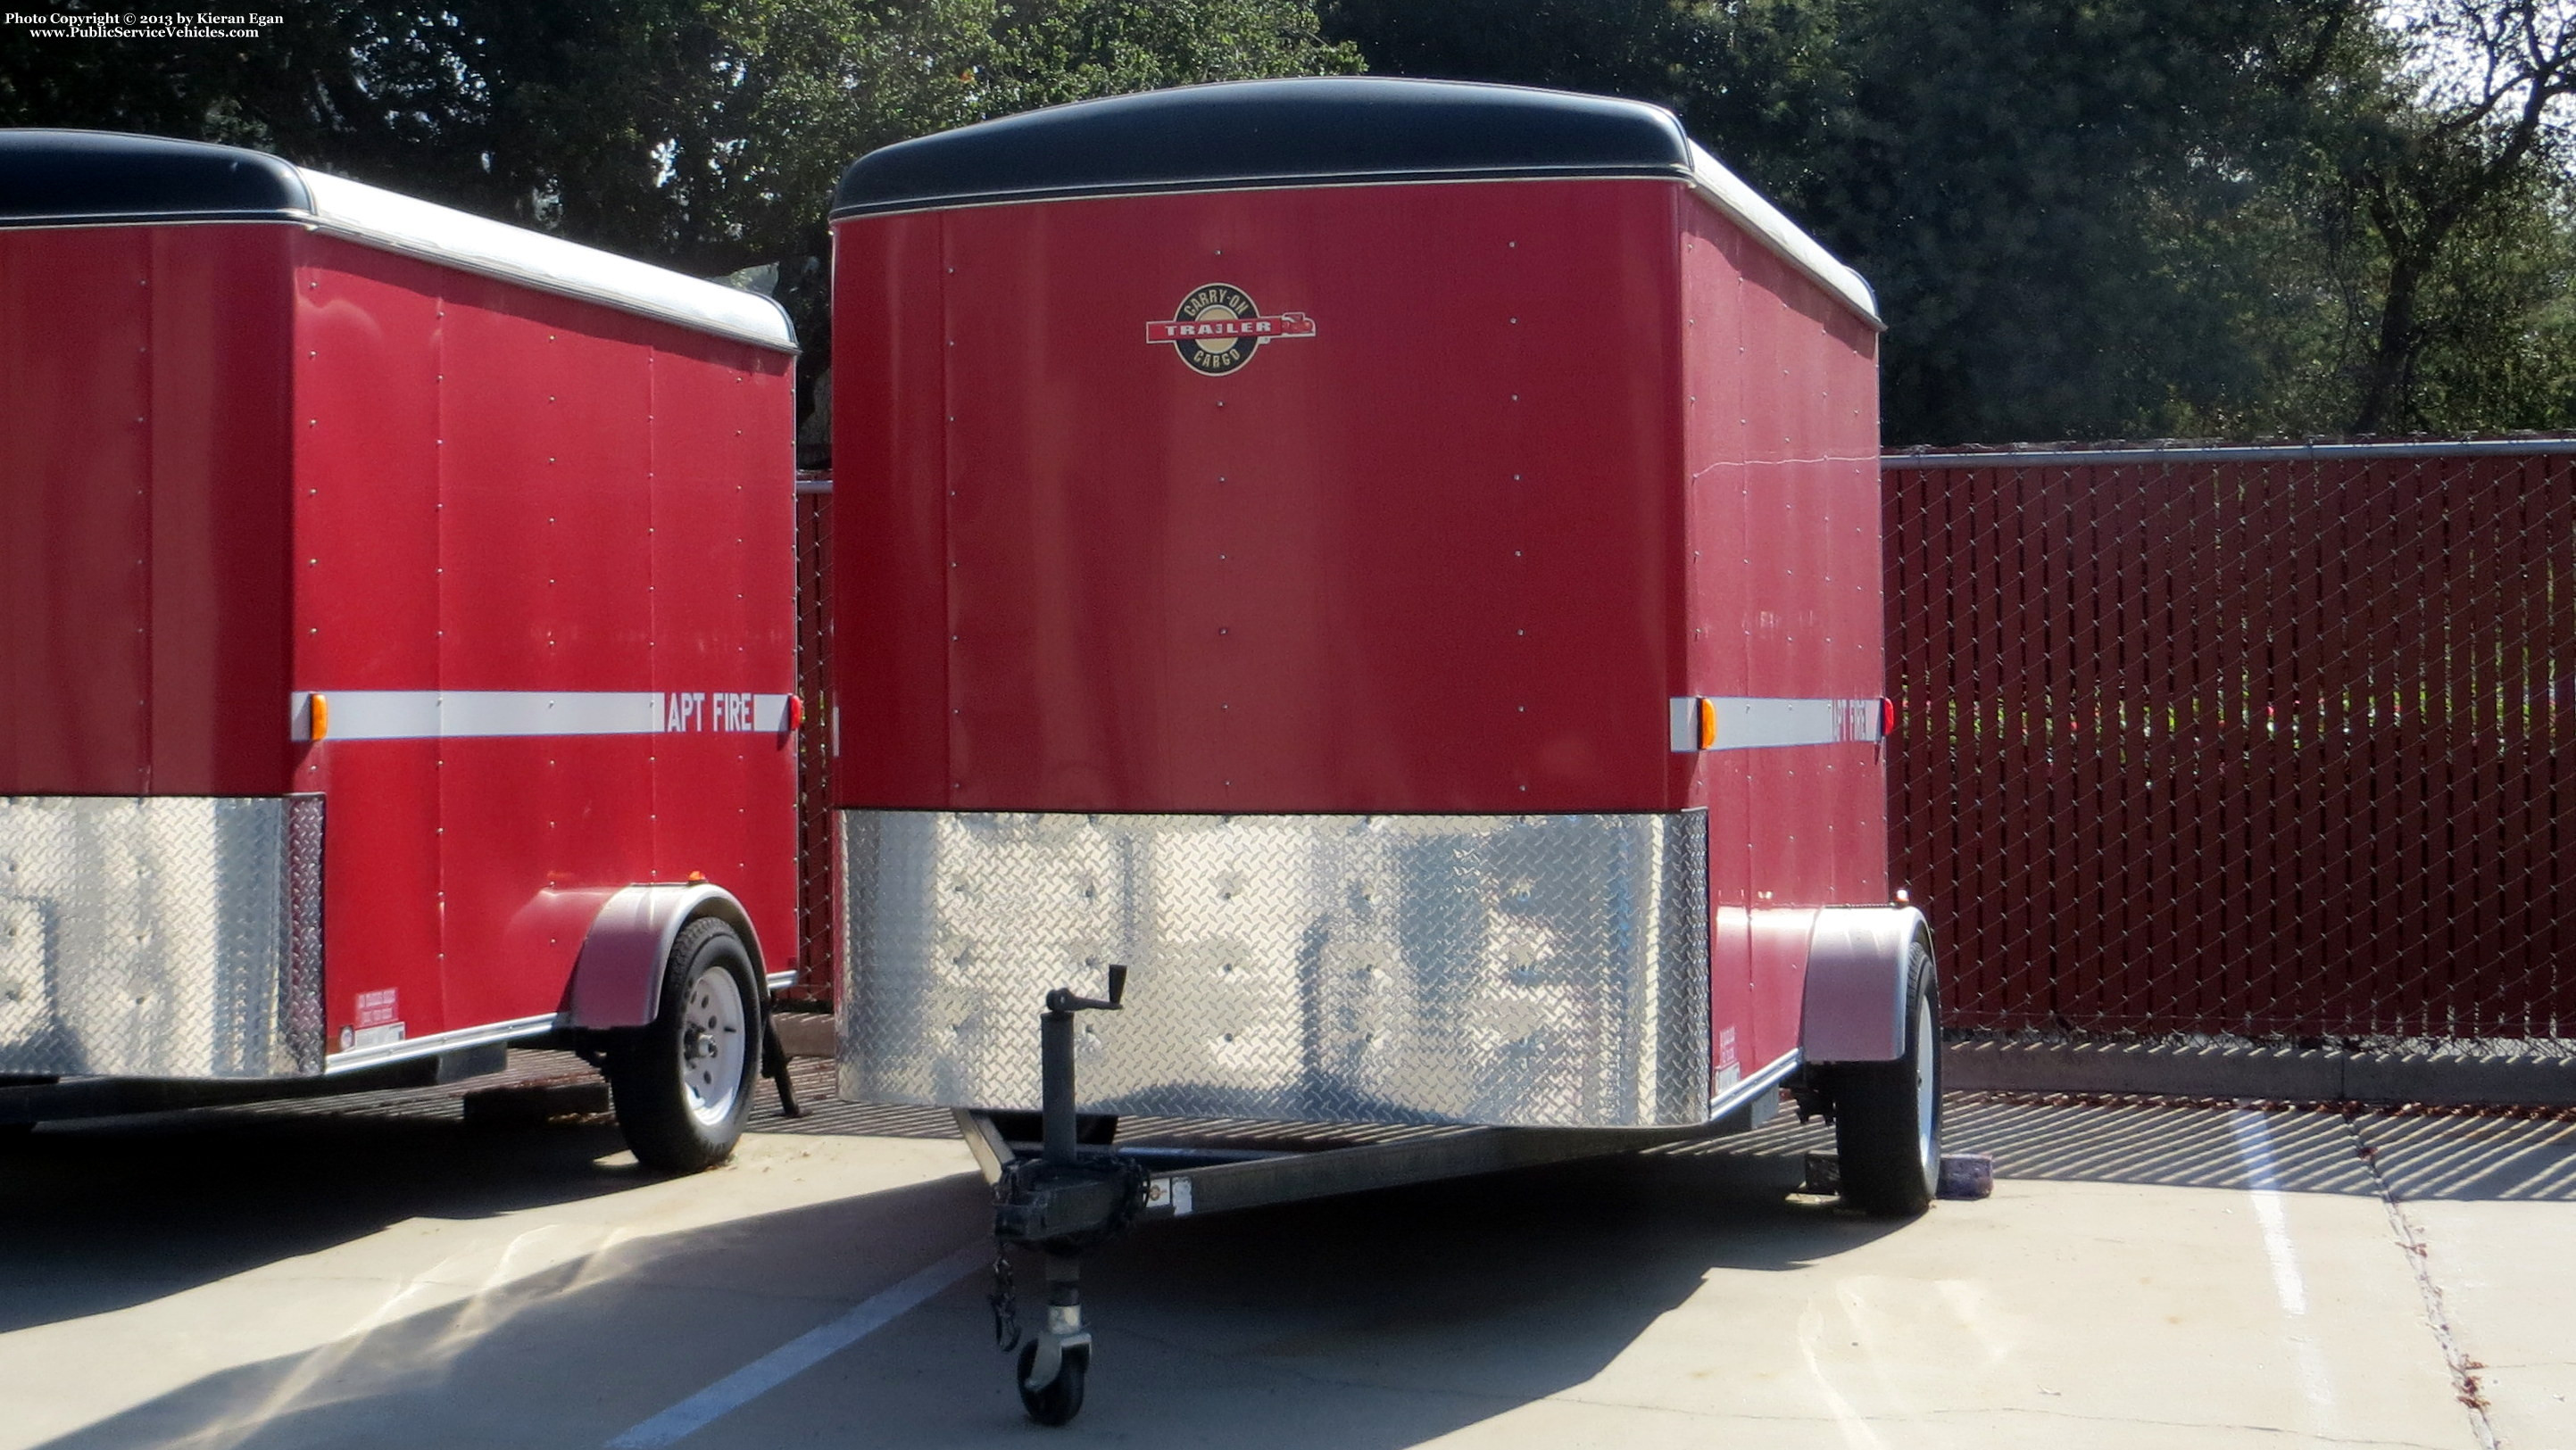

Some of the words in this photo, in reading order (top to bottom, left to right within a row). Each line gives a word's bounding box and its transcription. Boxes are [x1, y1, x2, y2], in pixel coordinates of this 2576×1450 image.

[1184, 288, 1249, 317] CARRY-ON
[1165, 321, 1271, 336] TRAILER
[1193, 348, 1240, 368] CARGO
[668, 692, 705, 733] APT
[713, 692, 752, 733] FIRE
